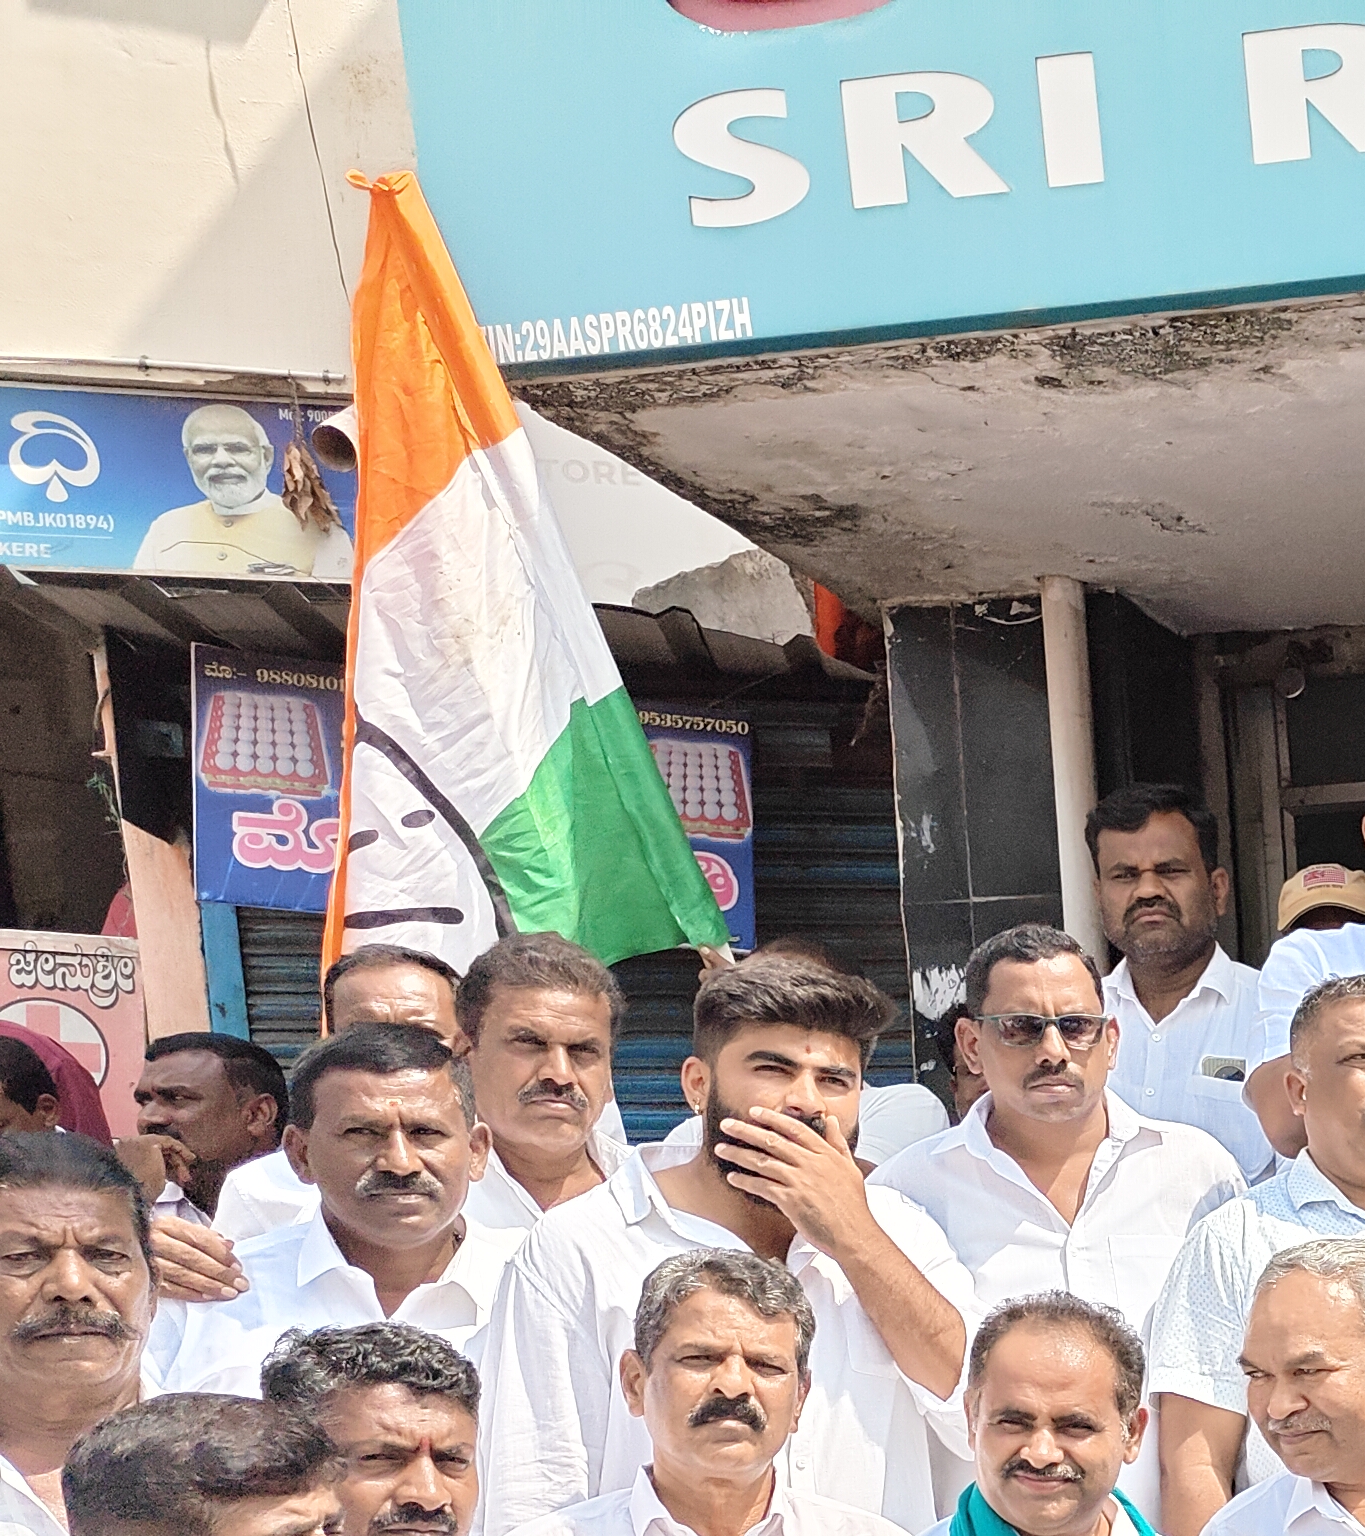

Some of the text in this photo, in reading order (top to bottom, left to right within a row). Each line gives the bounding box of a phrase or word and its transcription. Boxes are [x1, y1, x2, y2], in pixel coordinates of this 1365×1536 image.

[672, 50, 1105, 228] SRI
[639, 710, 749, 735] 9535757050
[9, 941, 136, 1009] ಜೇನುಶ್ರೀ
